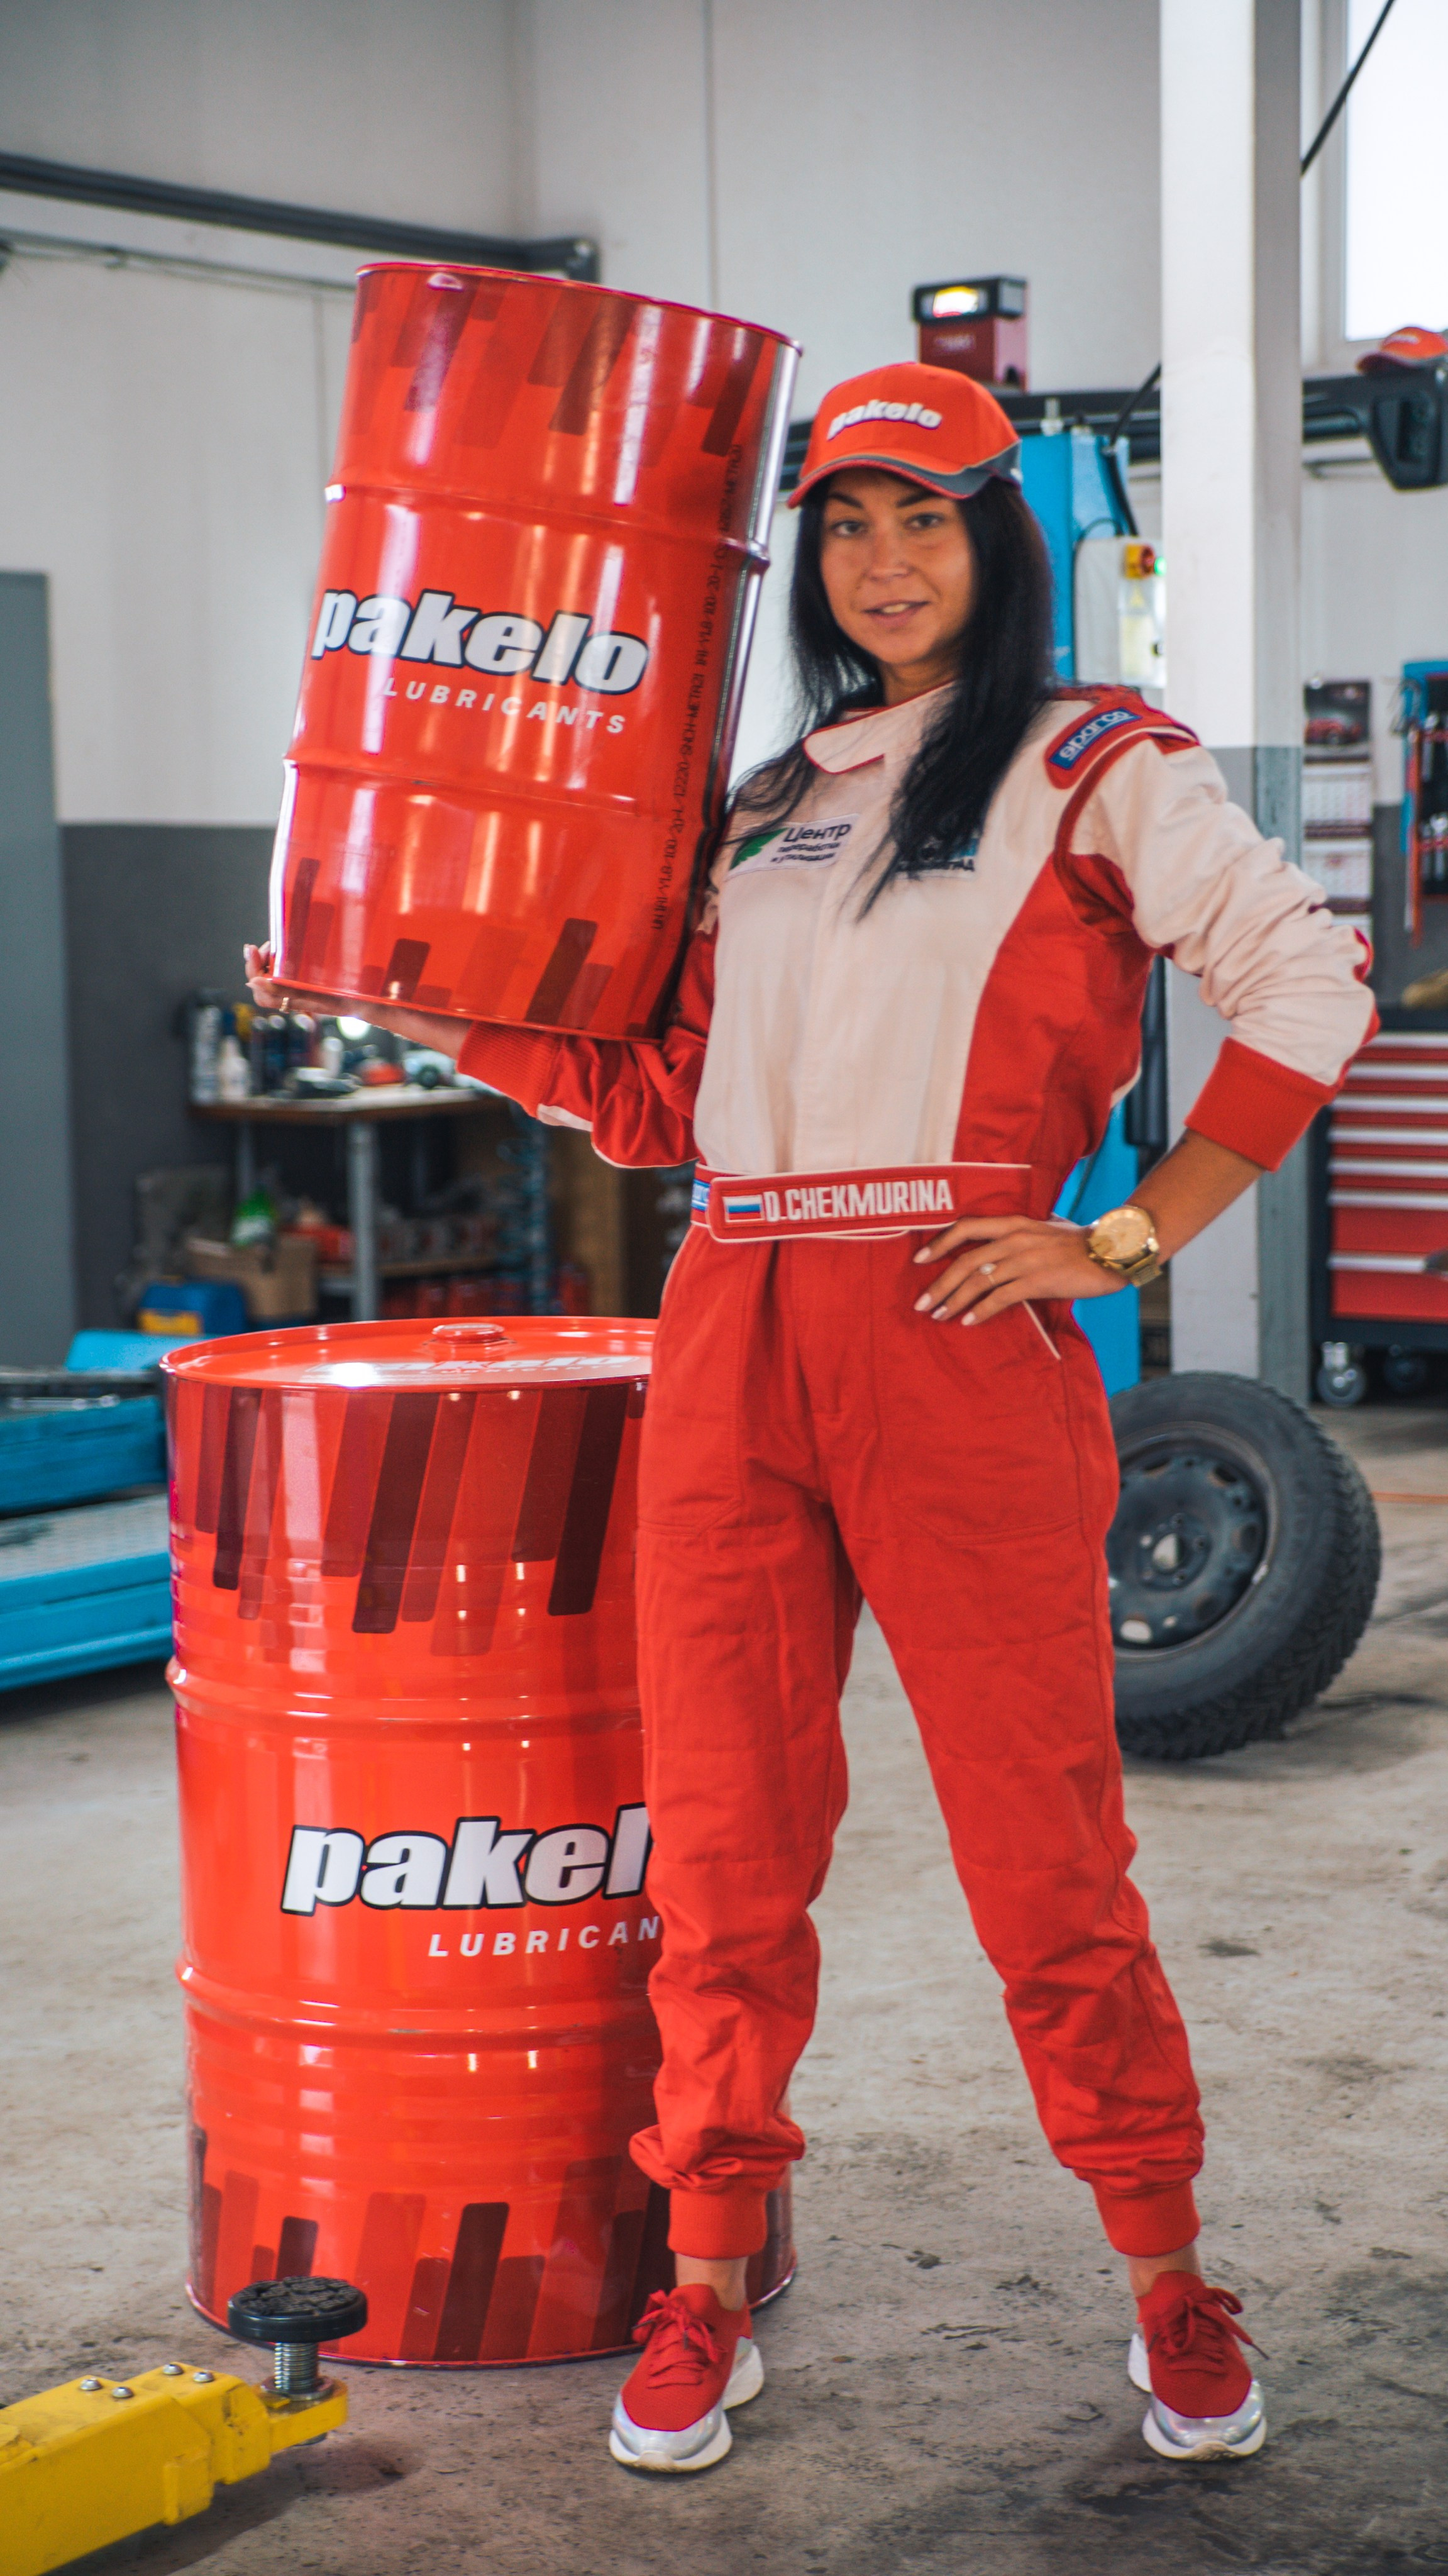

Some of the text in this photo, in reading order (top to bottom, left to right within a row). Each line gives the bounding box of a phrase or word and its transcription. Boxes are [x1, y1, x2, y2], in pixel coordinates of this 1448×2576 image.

[827, 399, 942, 441] pakelo
[311, 588, 650, 695] pakelo
[382, 678, 627, 733] LUBRICANTS
[1059, 710, 1132, 761] sparco
[783, 824, 852, 843] Центр
[763, 1179, 954, 1223] D.CHEKMURINA
[280, 1802, 655, 1917] pakel
[428, 1916, 660, 1957] LUBRICAN
